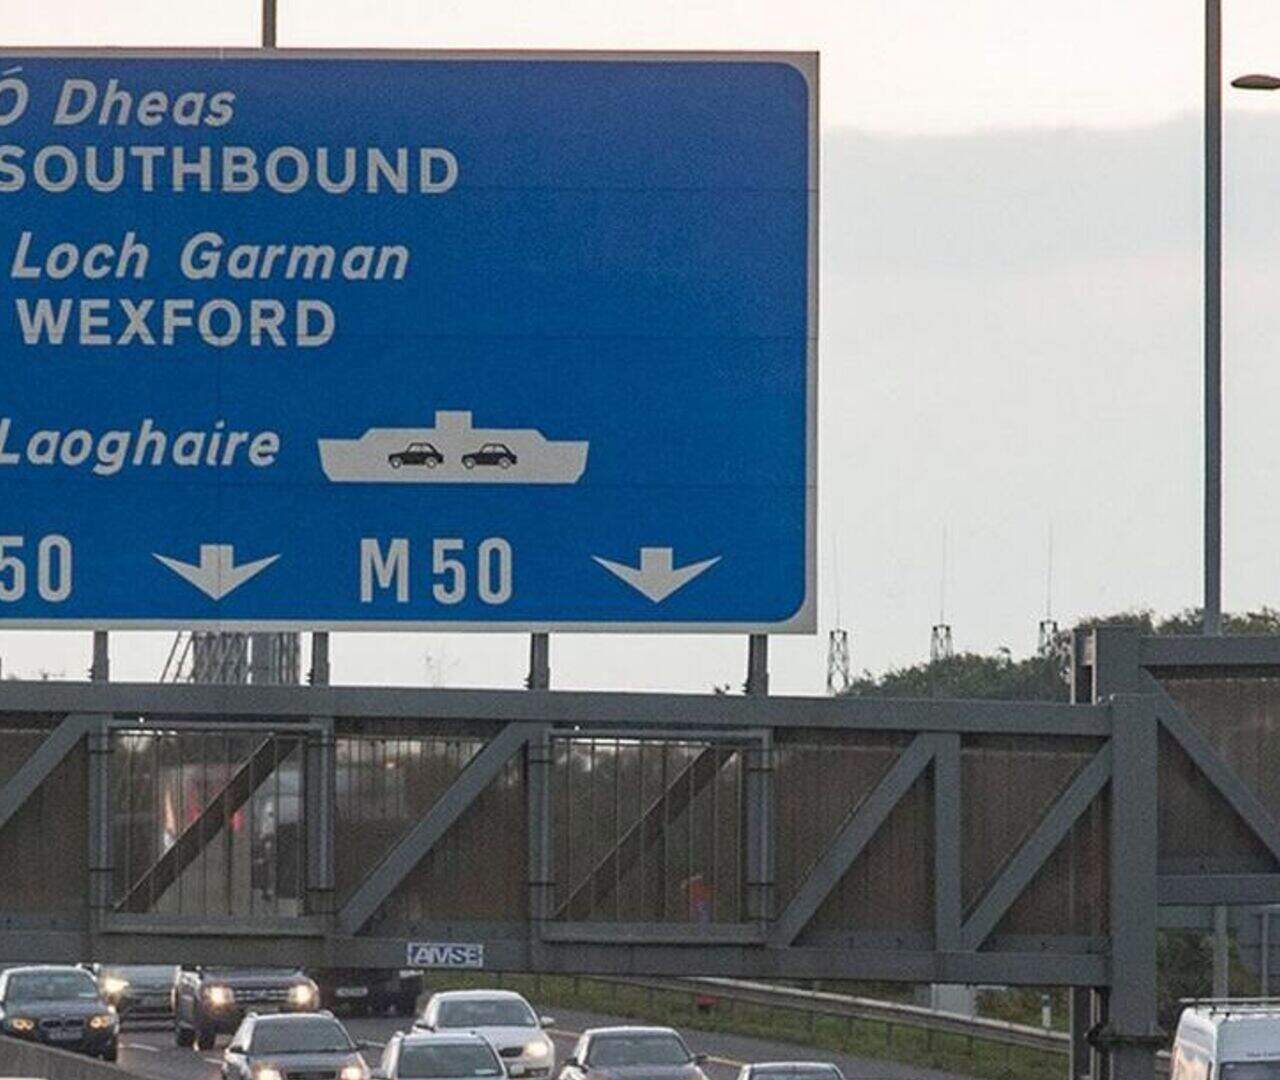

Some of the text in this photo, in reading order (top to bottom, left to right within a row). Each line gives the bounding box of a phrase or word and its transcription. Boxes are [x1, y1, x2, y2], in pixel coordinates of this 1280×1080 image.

[54, 78, 237, 126] Dheas
[10, 231, 411, 280] Loch Garman
[15, 298, 337, 346] WEXFORD
